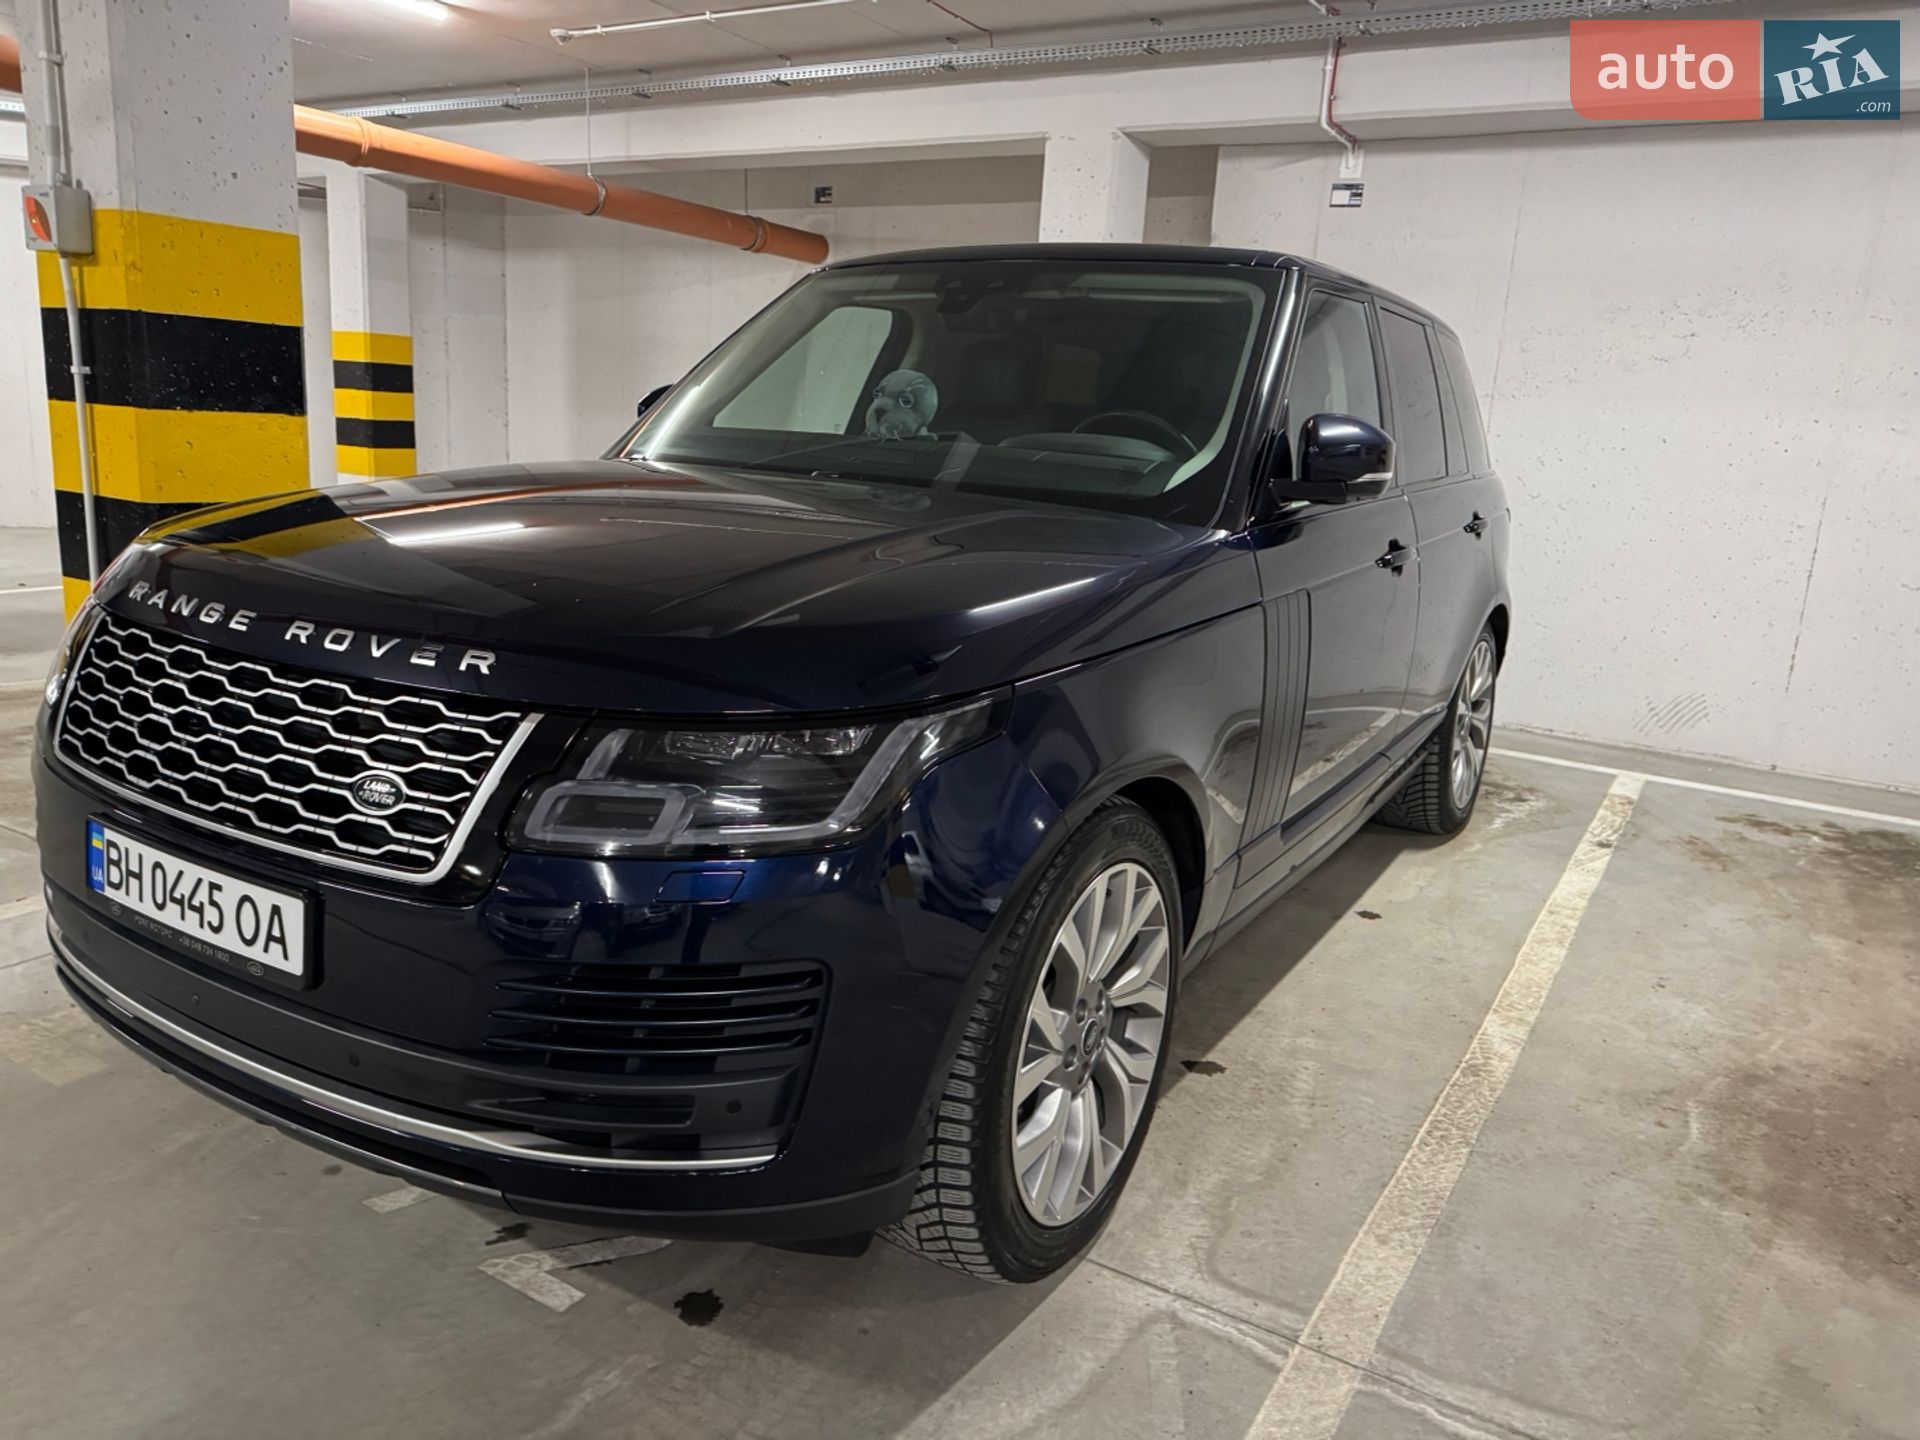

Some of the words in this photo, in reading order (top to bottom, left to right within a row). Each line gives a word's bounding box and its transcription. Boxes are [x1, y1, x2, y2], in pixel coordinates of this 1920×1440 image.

[128, 580, 257, 632] RANGE
[284, 620, 498, 675] ROVER
[106, 838, 144, 903] BH
[151, 860, 224, 934] 0445
[235, 893, 289, 961] OA
